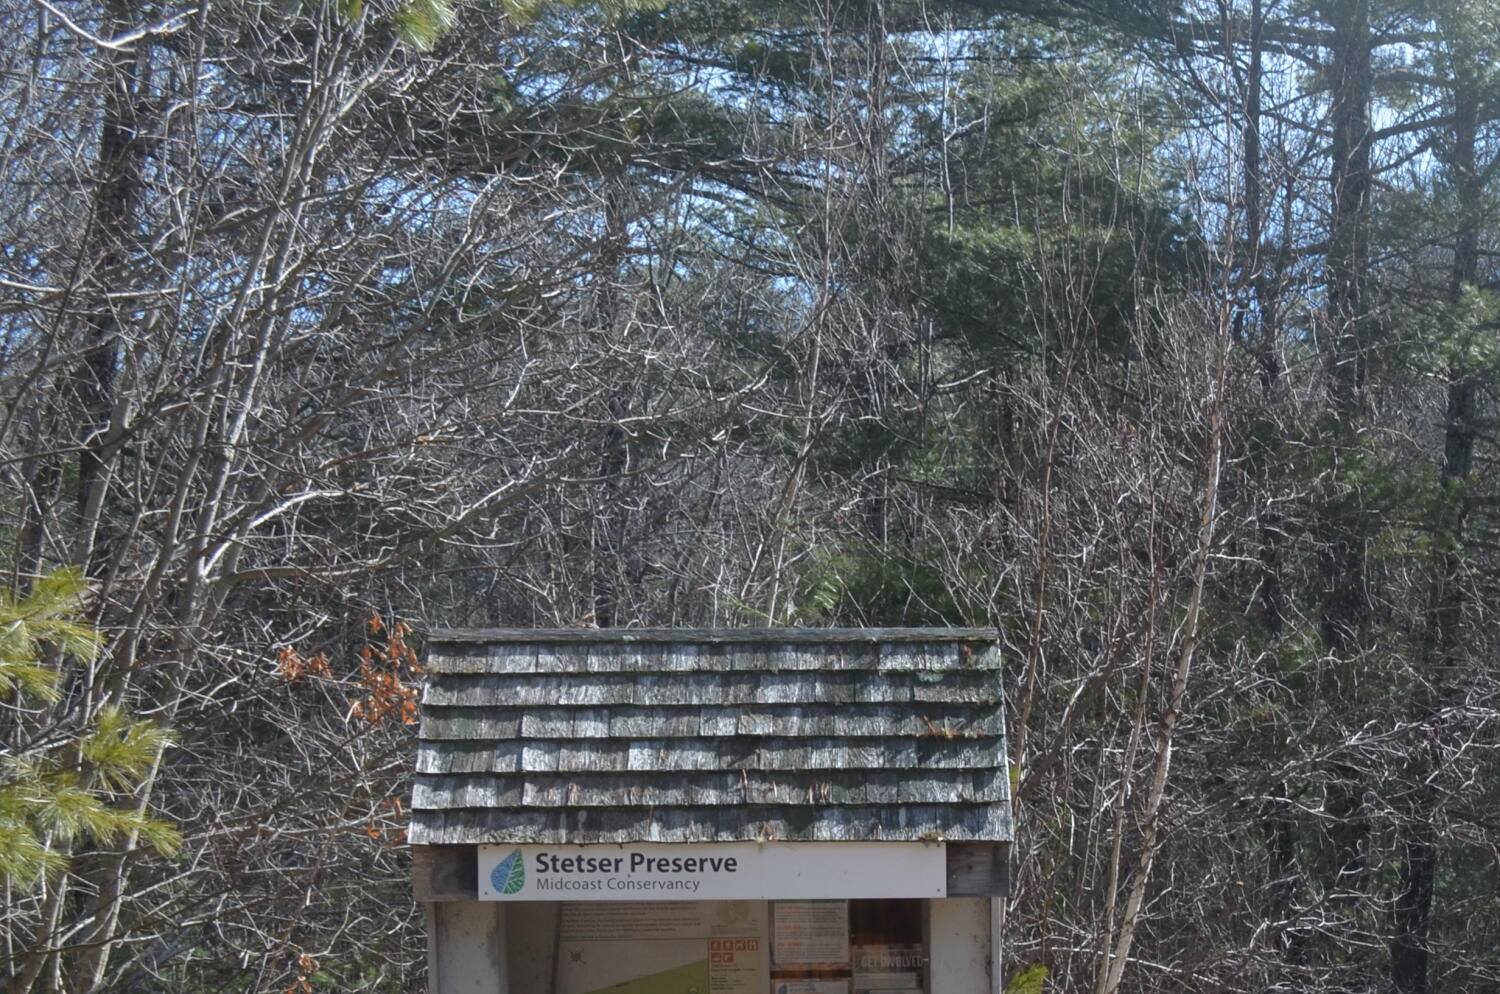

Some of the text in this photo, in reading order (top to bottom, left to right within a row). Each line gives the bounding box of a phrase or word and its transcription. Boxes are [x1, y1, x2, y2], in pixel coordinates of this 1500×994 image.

[535, 852, 738, 873] Stetser Preserve
[536, 877, 700, 892] Midcoast Conservancy
[861, 955, 923, 968] GET INVOLVED
